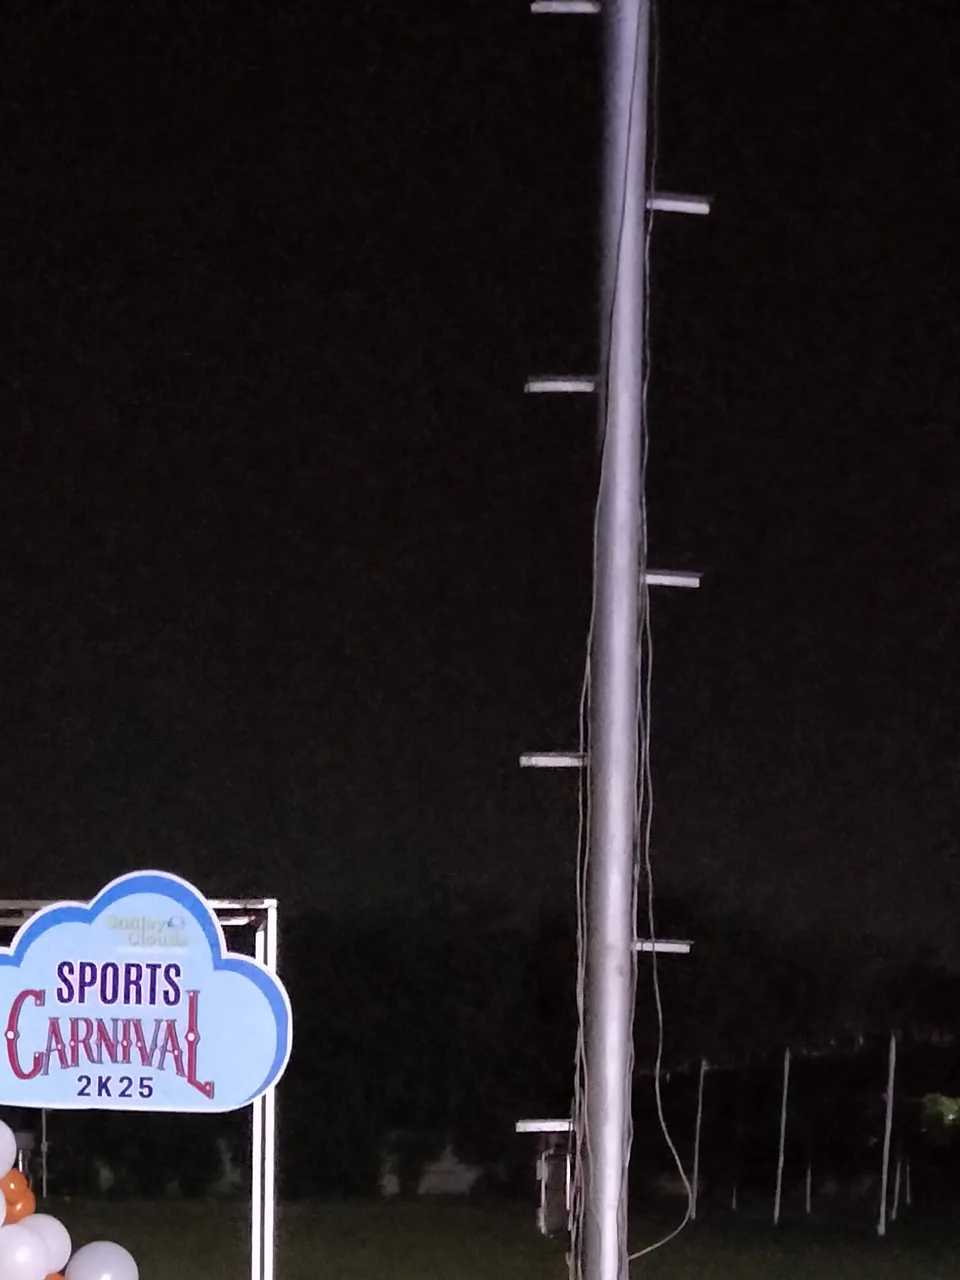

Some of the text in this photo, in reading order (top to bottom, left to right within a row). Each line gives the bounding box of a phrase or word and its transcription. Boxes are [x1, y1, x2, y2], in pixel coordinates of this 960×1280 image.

[56, 961, 182, 1005] SPORTS
[4, 988, 215, 1100] CARNIVAL
[76, 1075, 154, 1098] 2K25
